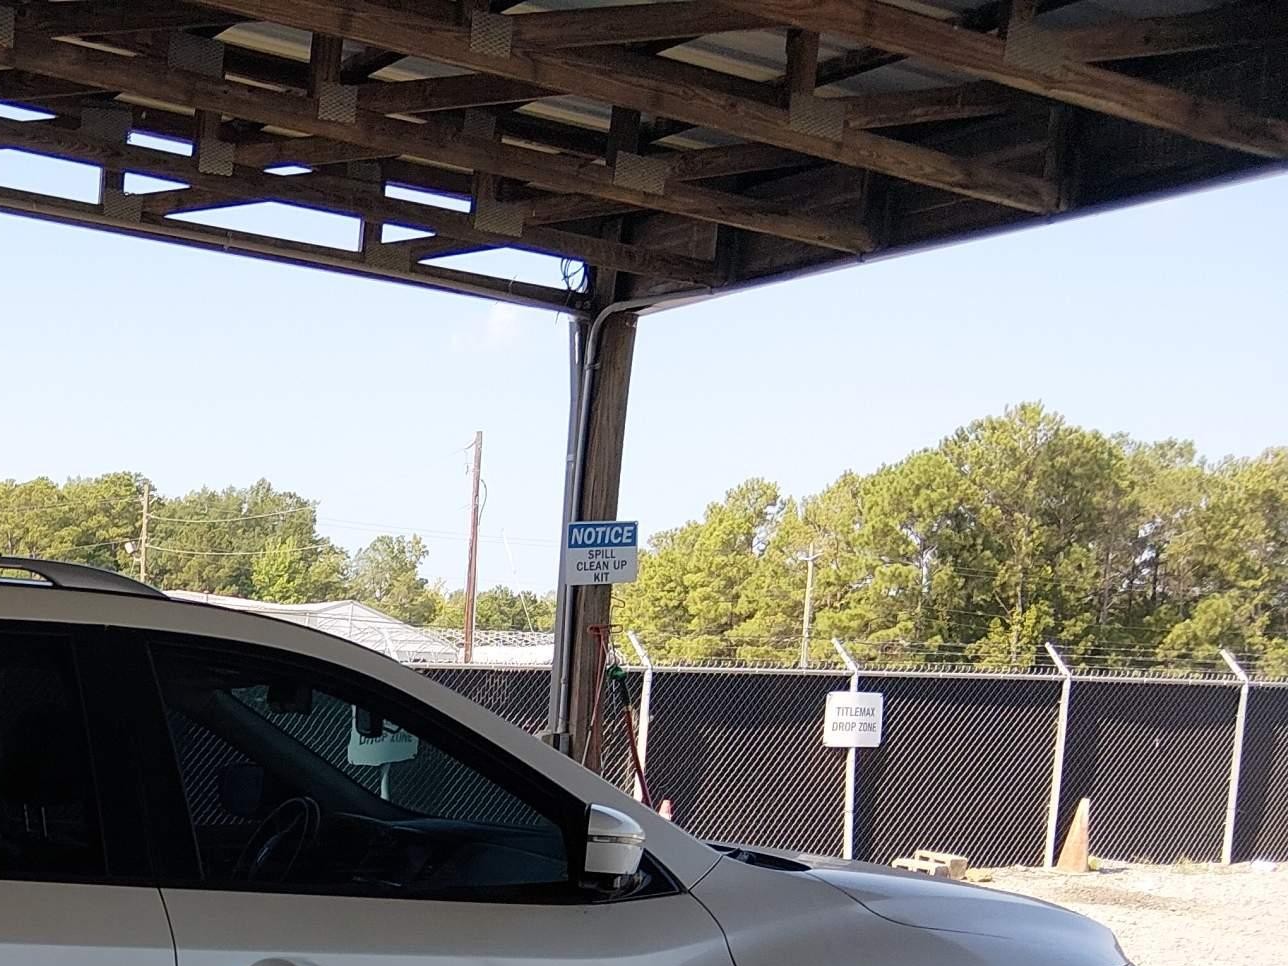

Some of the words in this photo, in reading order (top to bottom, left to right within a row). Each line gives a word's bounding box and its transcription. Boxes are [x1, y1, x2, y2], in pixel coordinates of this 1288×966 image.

[571, 526, 634, 545] NOTICE
[588, 549, 616, 560] SPILL
[576, 561, 609, 572] CLEAN
[613, 560, 628, 570] UP
[593, 572, 610, 583] KIT
[836, 706, 876, 718] TITLEMAX
[831, 722, 857, 732] DROP
[858, 722, 878, 732] ZONE
